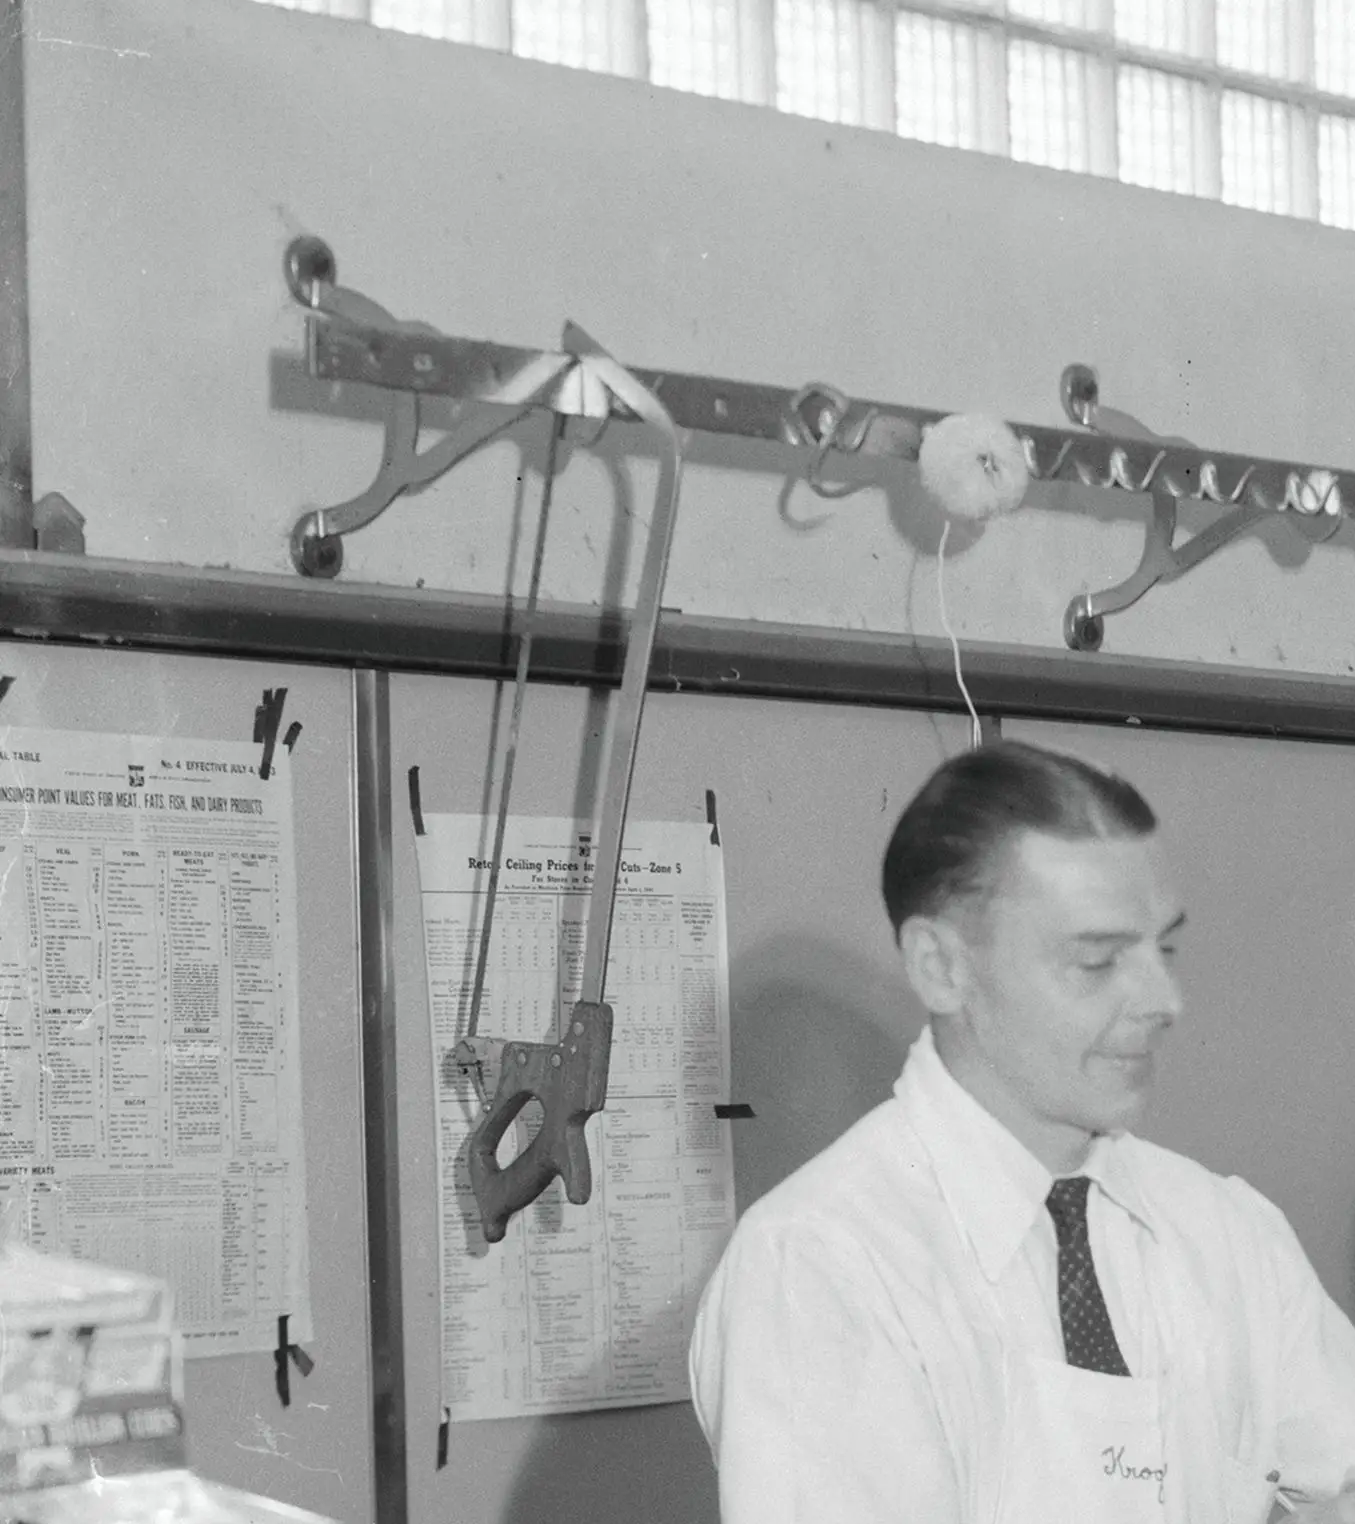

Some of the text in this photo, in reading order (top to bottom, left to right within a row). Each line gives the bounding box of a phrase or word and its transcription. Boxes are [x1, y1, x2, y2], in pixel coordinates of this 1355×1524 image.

[65, 789, 96, 807] VALUES
[99, 790, 114, 808] FOR
[506, 858, 542, 872] Ceiling
[547, 859, 578, 871] Prices
